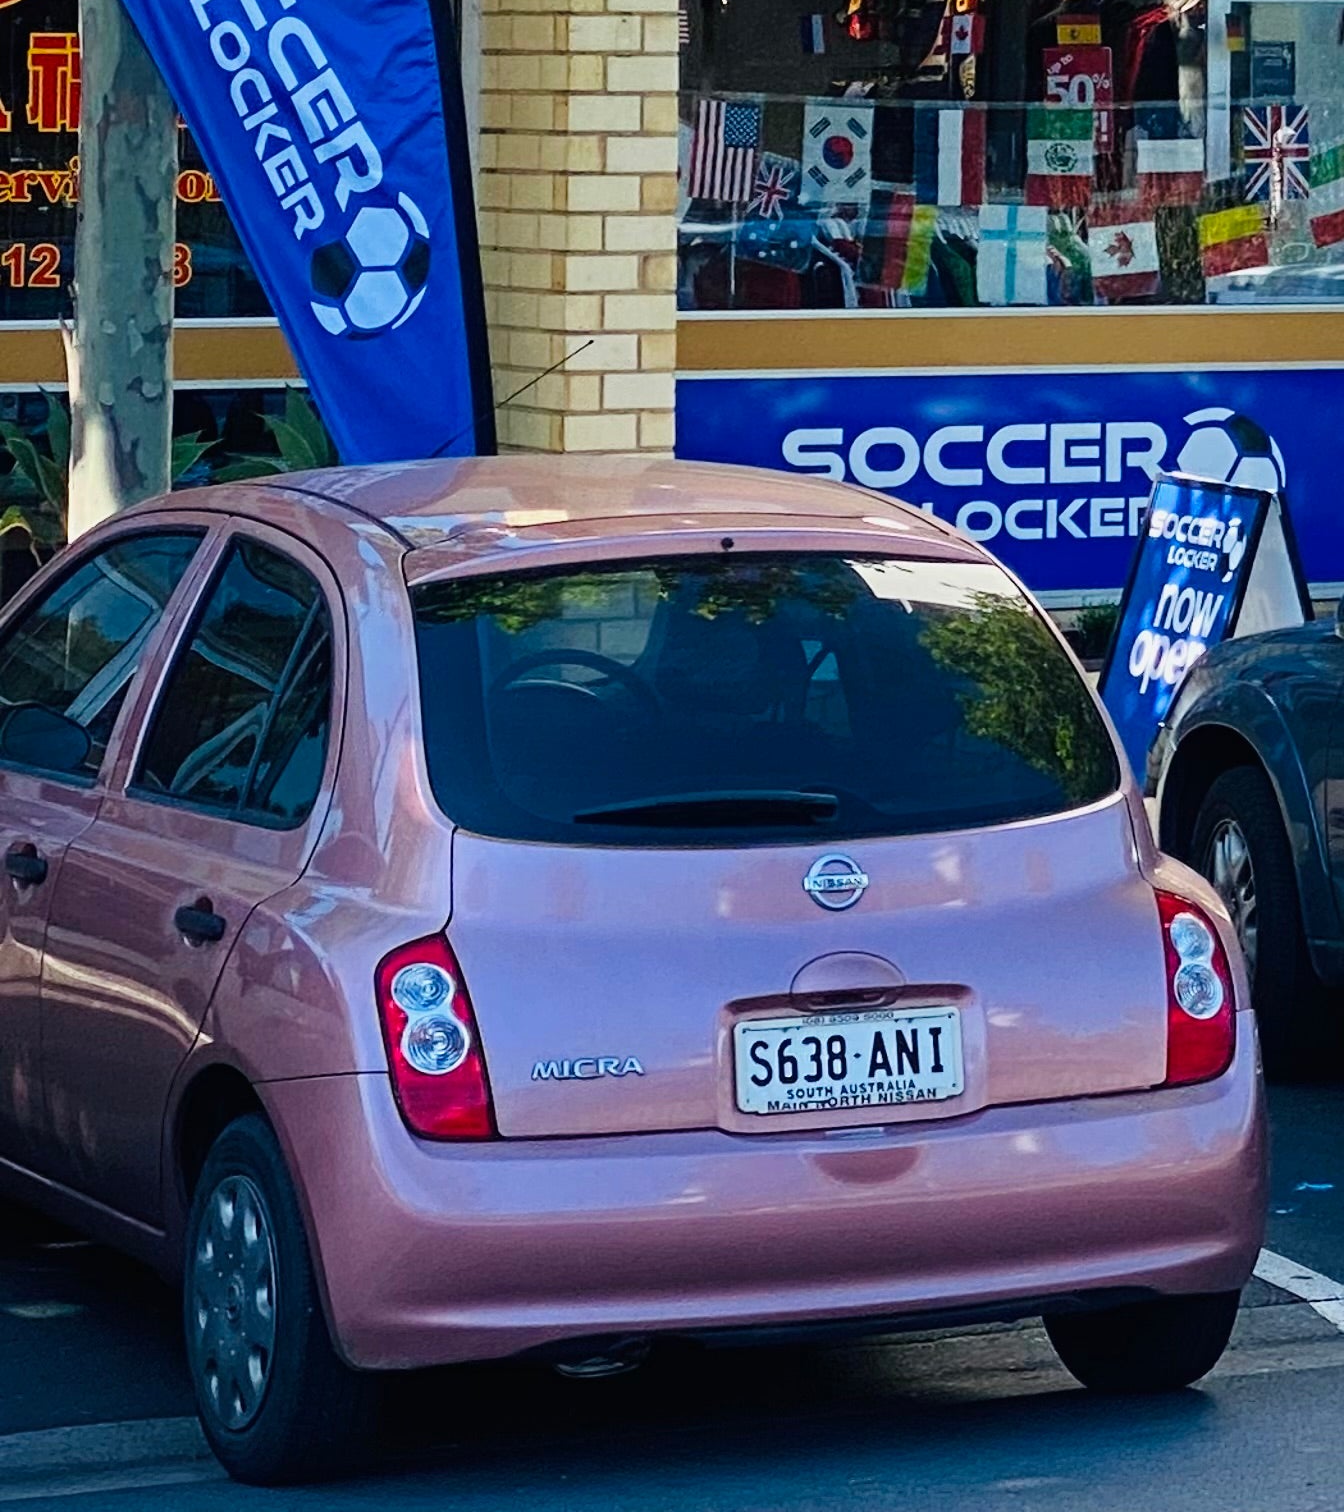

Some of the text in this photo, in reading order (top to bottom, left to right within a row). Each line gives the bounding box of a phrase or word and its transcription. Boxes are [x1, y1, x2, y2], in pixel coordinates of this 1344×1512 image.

[782, 422, 1168, 488] SOCCER
[1149, 510, 1225, 549] SOCCER
[1167, 545, 1218, 571] LOCKER
[1153, 584, 1224, 637] now
[813, 878, 863, 888] NISSAN
[532, 1057, 645, 1080] MICRA
[787, 1080, 916, 1100] SOUTH AUSTRALIA
[878, 1088, 937, 1103] NISSAN
